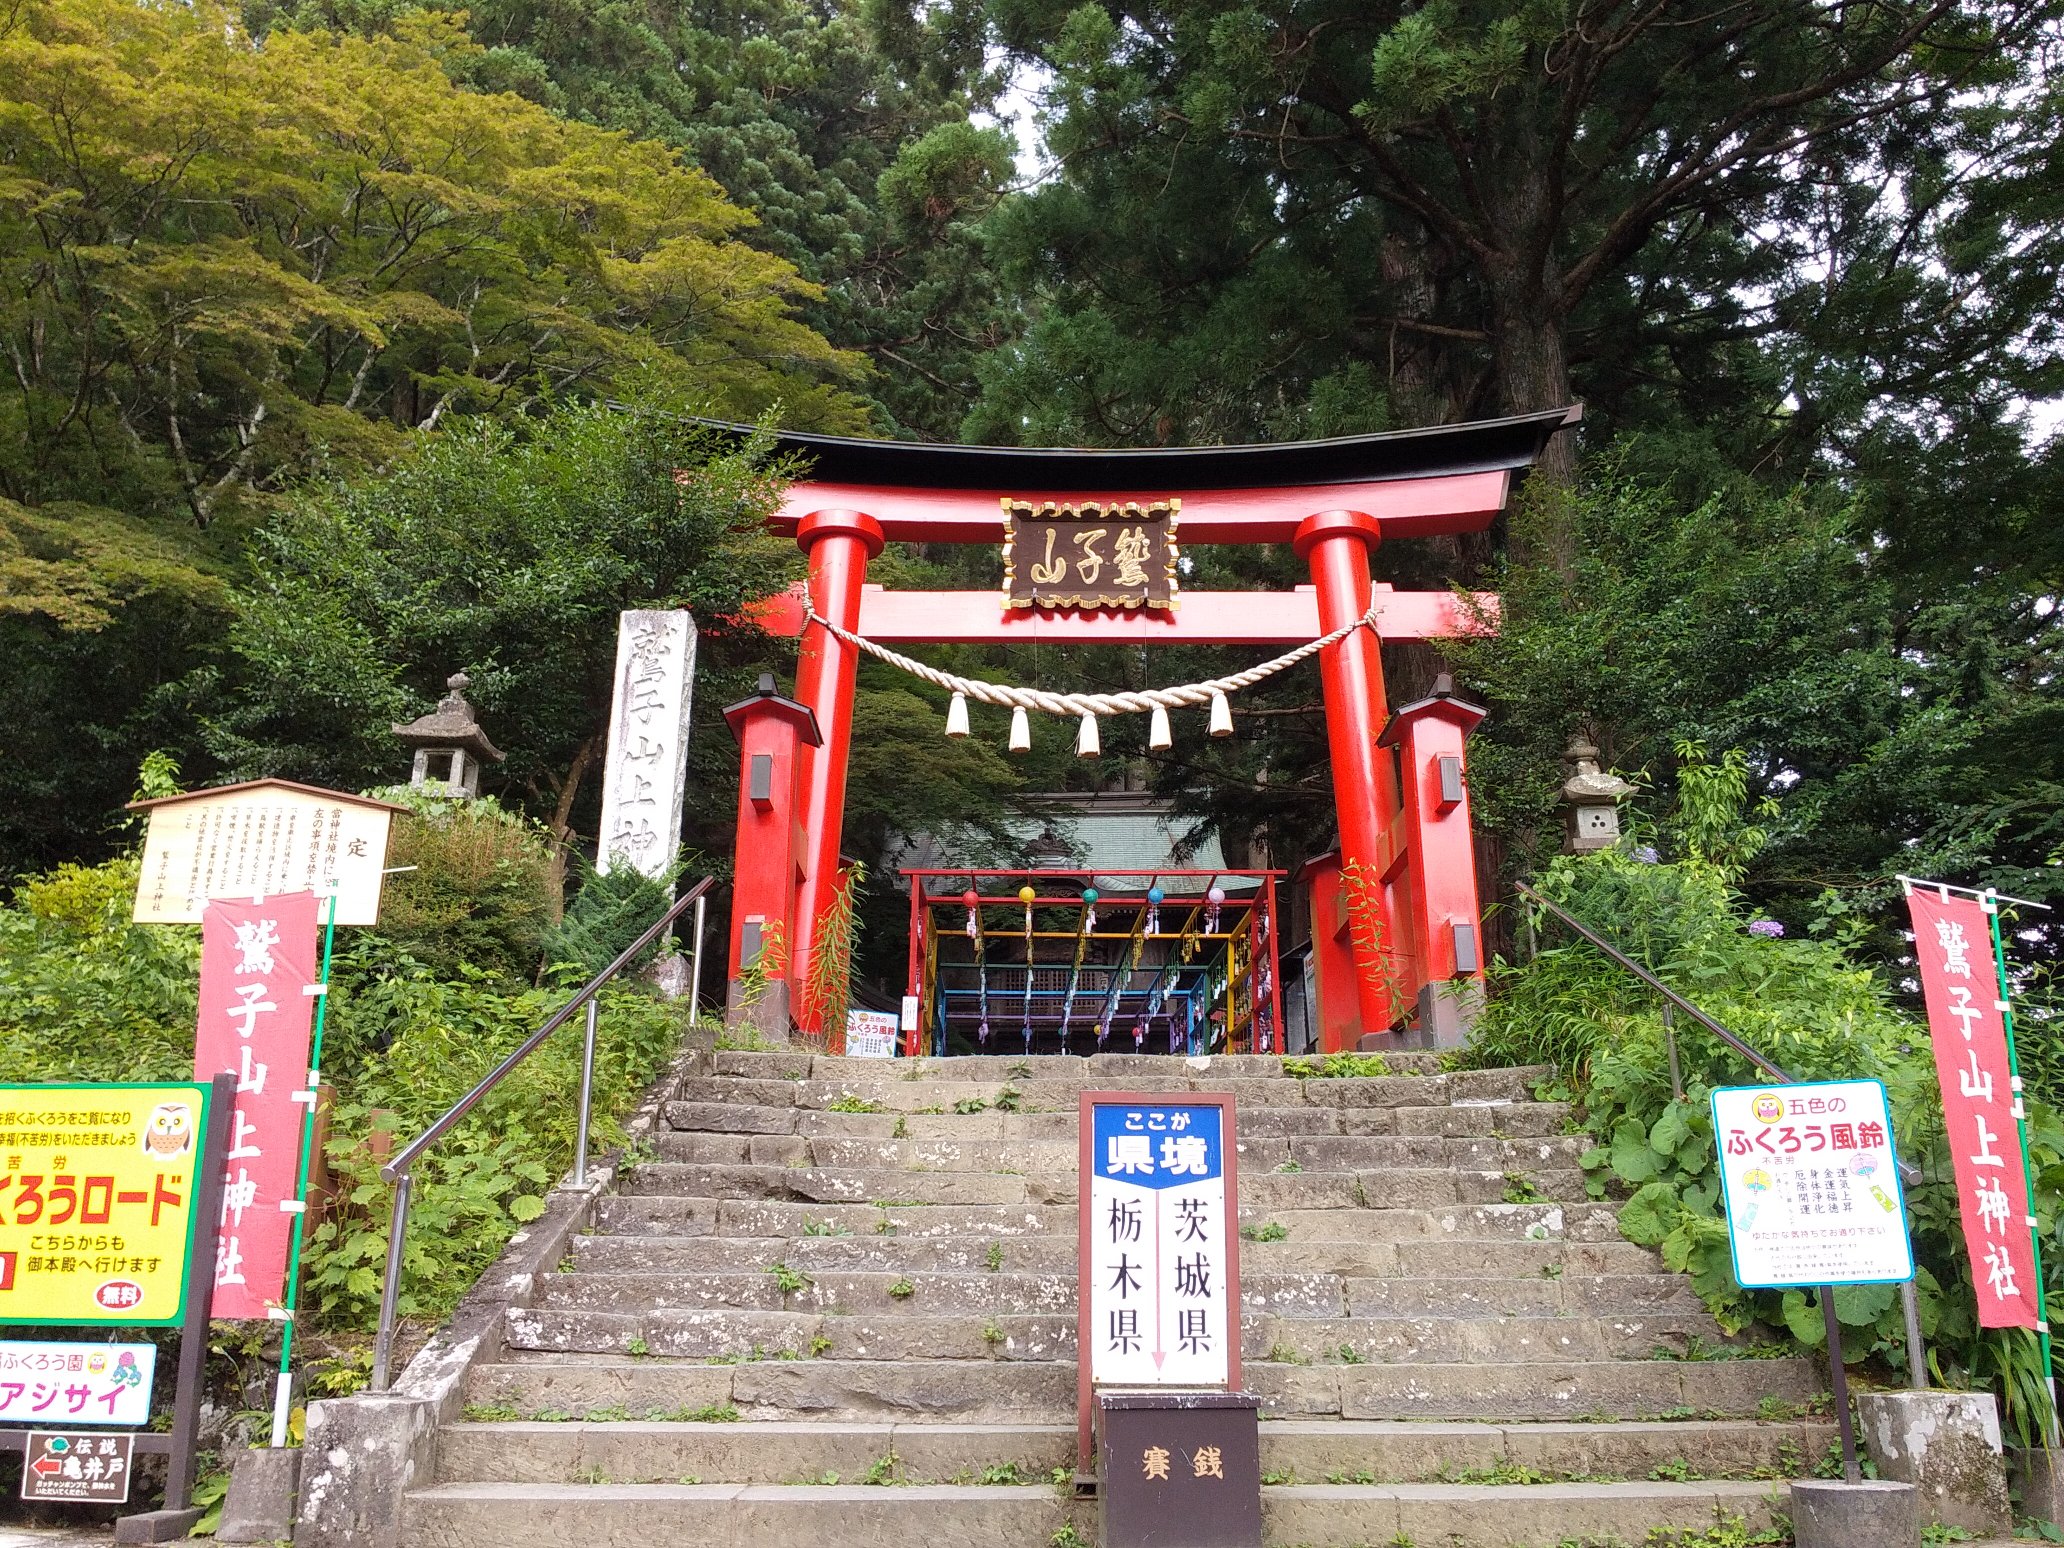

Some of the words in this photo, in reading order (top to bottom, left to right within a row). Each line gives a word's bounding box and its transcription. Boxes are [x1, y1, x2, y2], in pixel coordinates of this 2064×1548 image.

[347, 837, 368, 858] 定
[1124, 1112, 1191, 1131] ここが
[1788, 1097, 1846, 1116] 五色の
[1935, 918, 2021, 1301] 鷲子山上神社
[1727, 1121, 1884, 1155] ふくろう風鈴
[1106, 1135, 1208, 1175] 県境
[1794, 1170, 1811, 1214] 厄除開運
[1824, 1168, 1839, 1213] 金運福徳
[1836, 1167, 1853, 1212] 運気上昇
[31, 1235, 125, 1250] こちらからも
[28, 1256, 161, 1273] 御本殿へ行けます
[1106, 1197, 1143, 1355] 栃木県
[1174, 1197, 1212, 1355] 茨城県
[102, 1286, 138, 1305] 無料
[0, 1353, 83, 1372] ふくろう園
[0, 1382, 126, 1415] アジサイ
[74, 1438, 118, 1456] 伝説
[1142, 1446, 1224, 1480] 賽銭
[63, 1455, 125, 1480] 亀井戸
